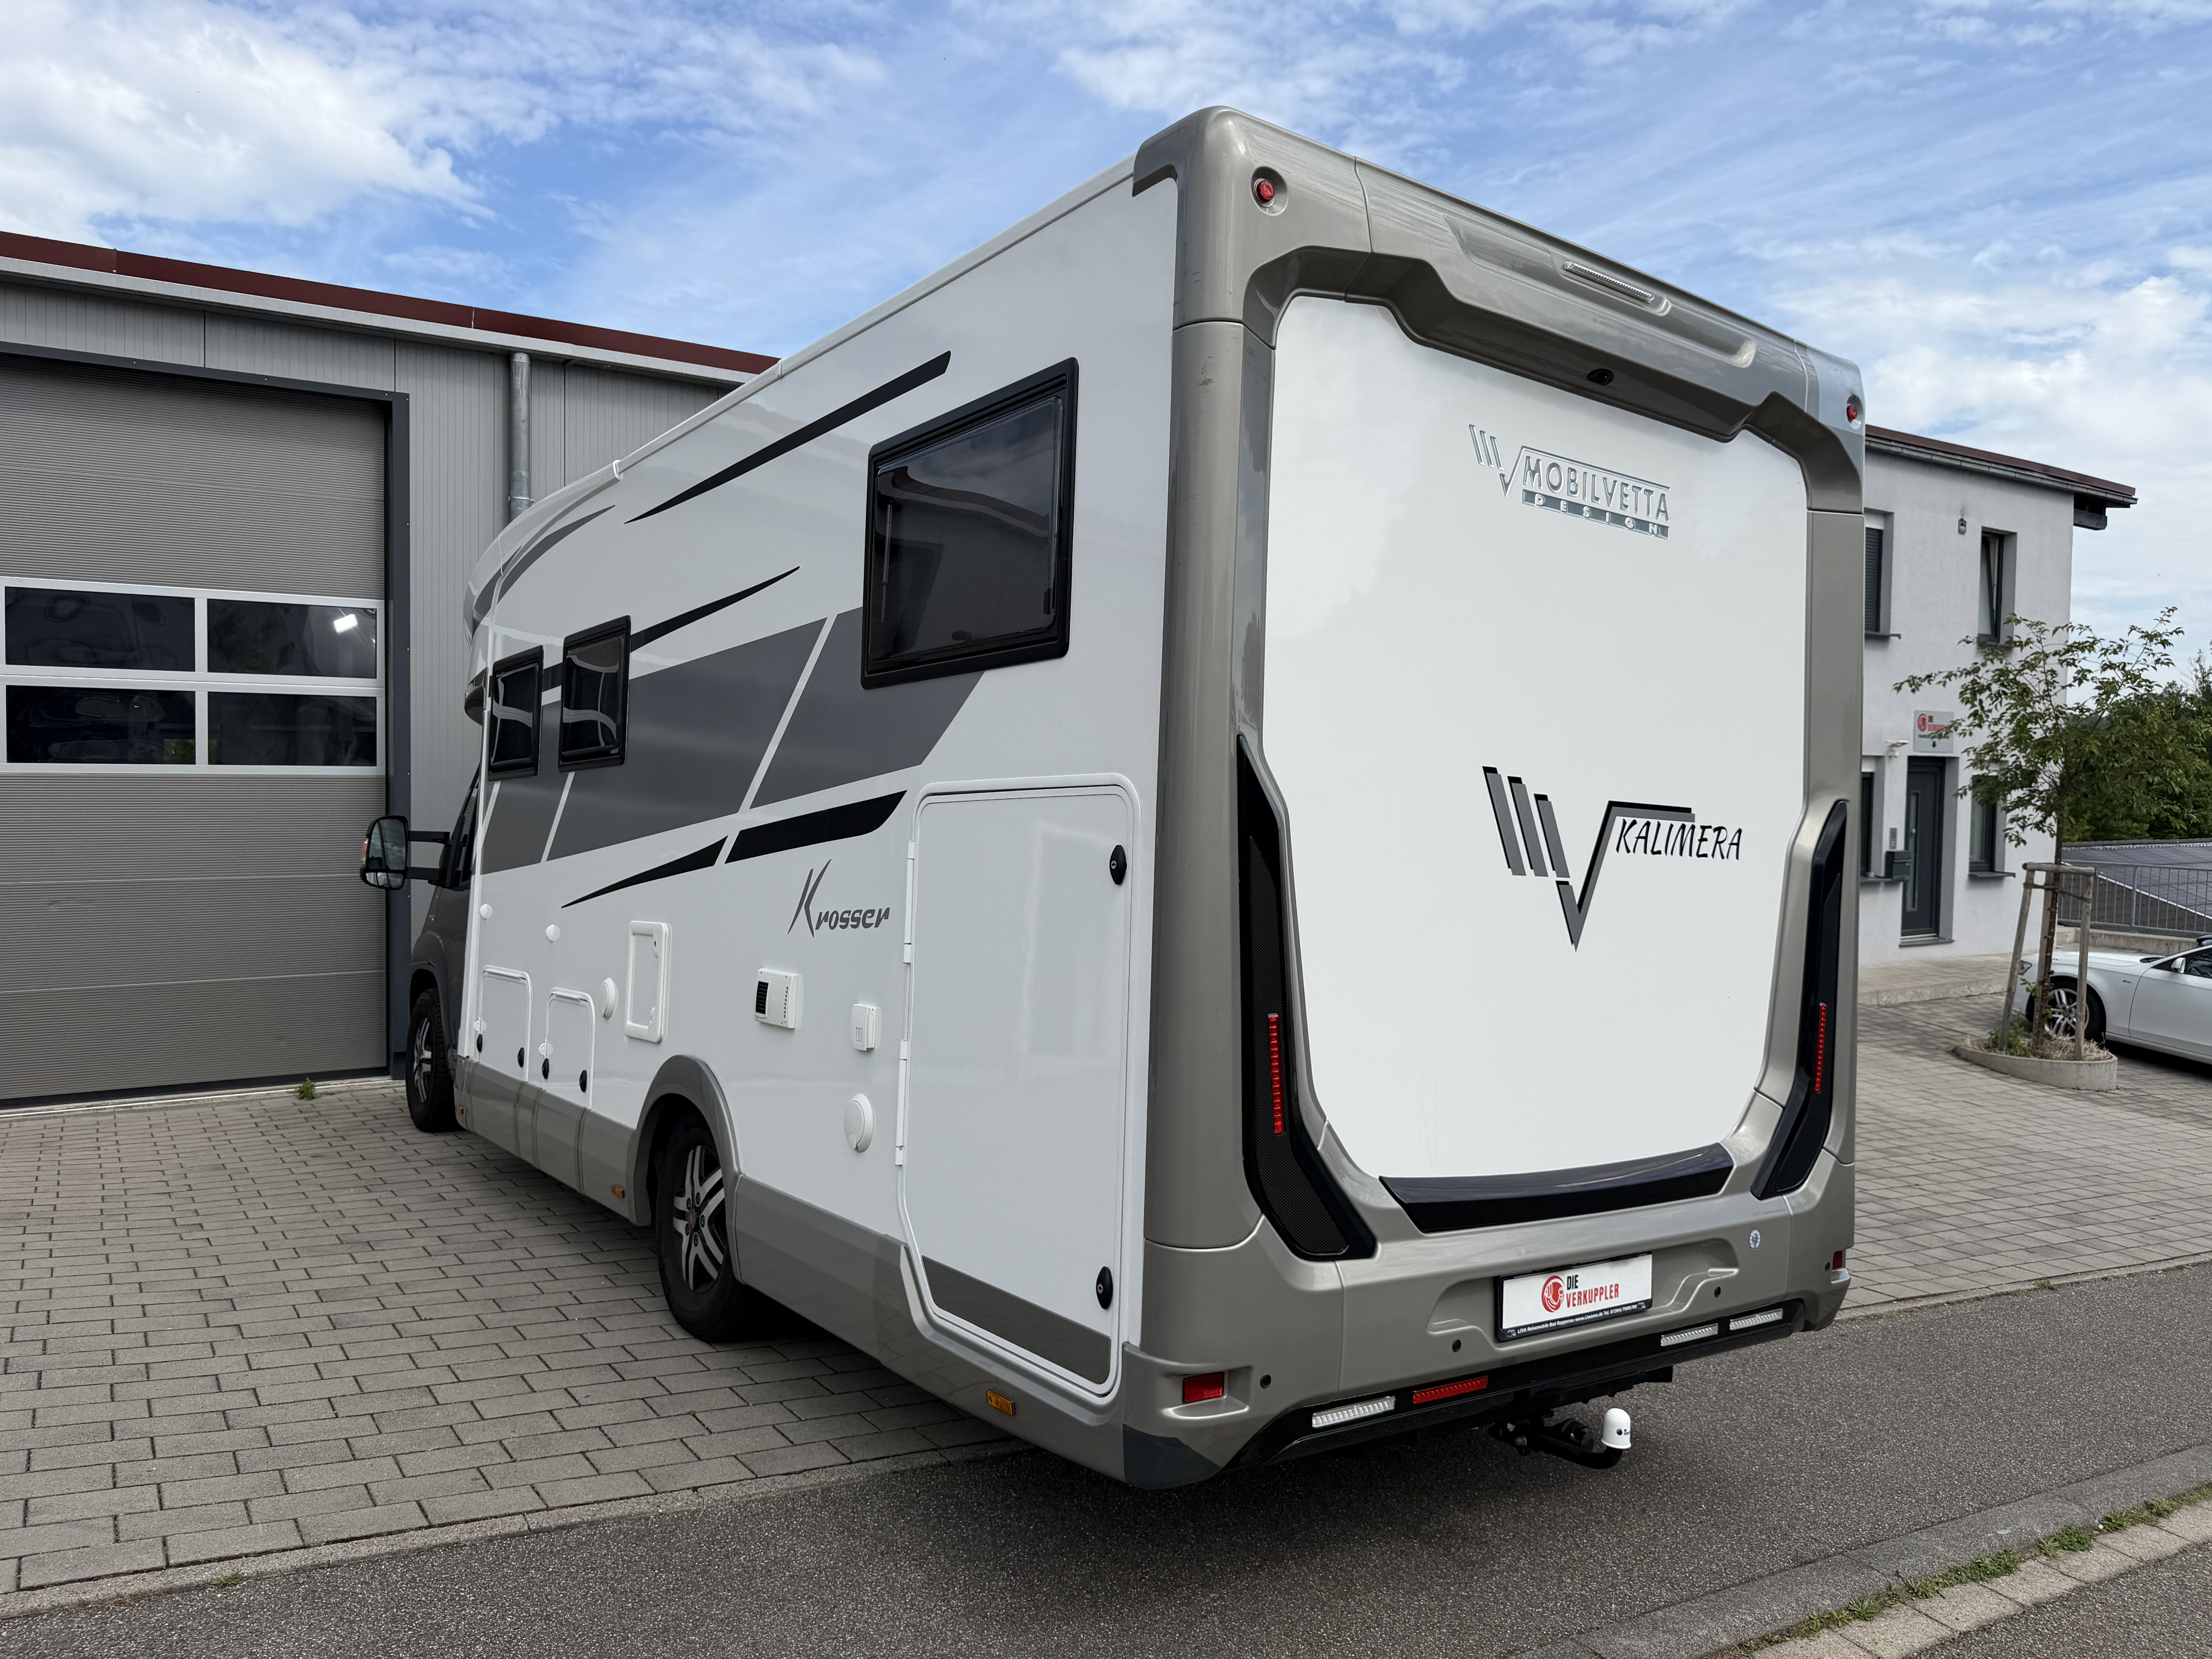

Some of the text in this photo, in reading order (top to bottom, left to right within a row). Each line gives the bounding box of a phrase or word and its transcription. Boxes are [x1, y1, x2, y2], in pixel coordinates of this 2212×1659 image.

[1522, 455, 1670, 523] MOBILVETTA
[1534, 493, 1659, 536] DESIGN
[1616, 818, 1743, 860] KALIMERA
[787, 858, 890, 938] Krosser
[1566, 1274, 1579, 1290] DIE
[1566, 1283, 1620, 1308] VERKUPPLER
